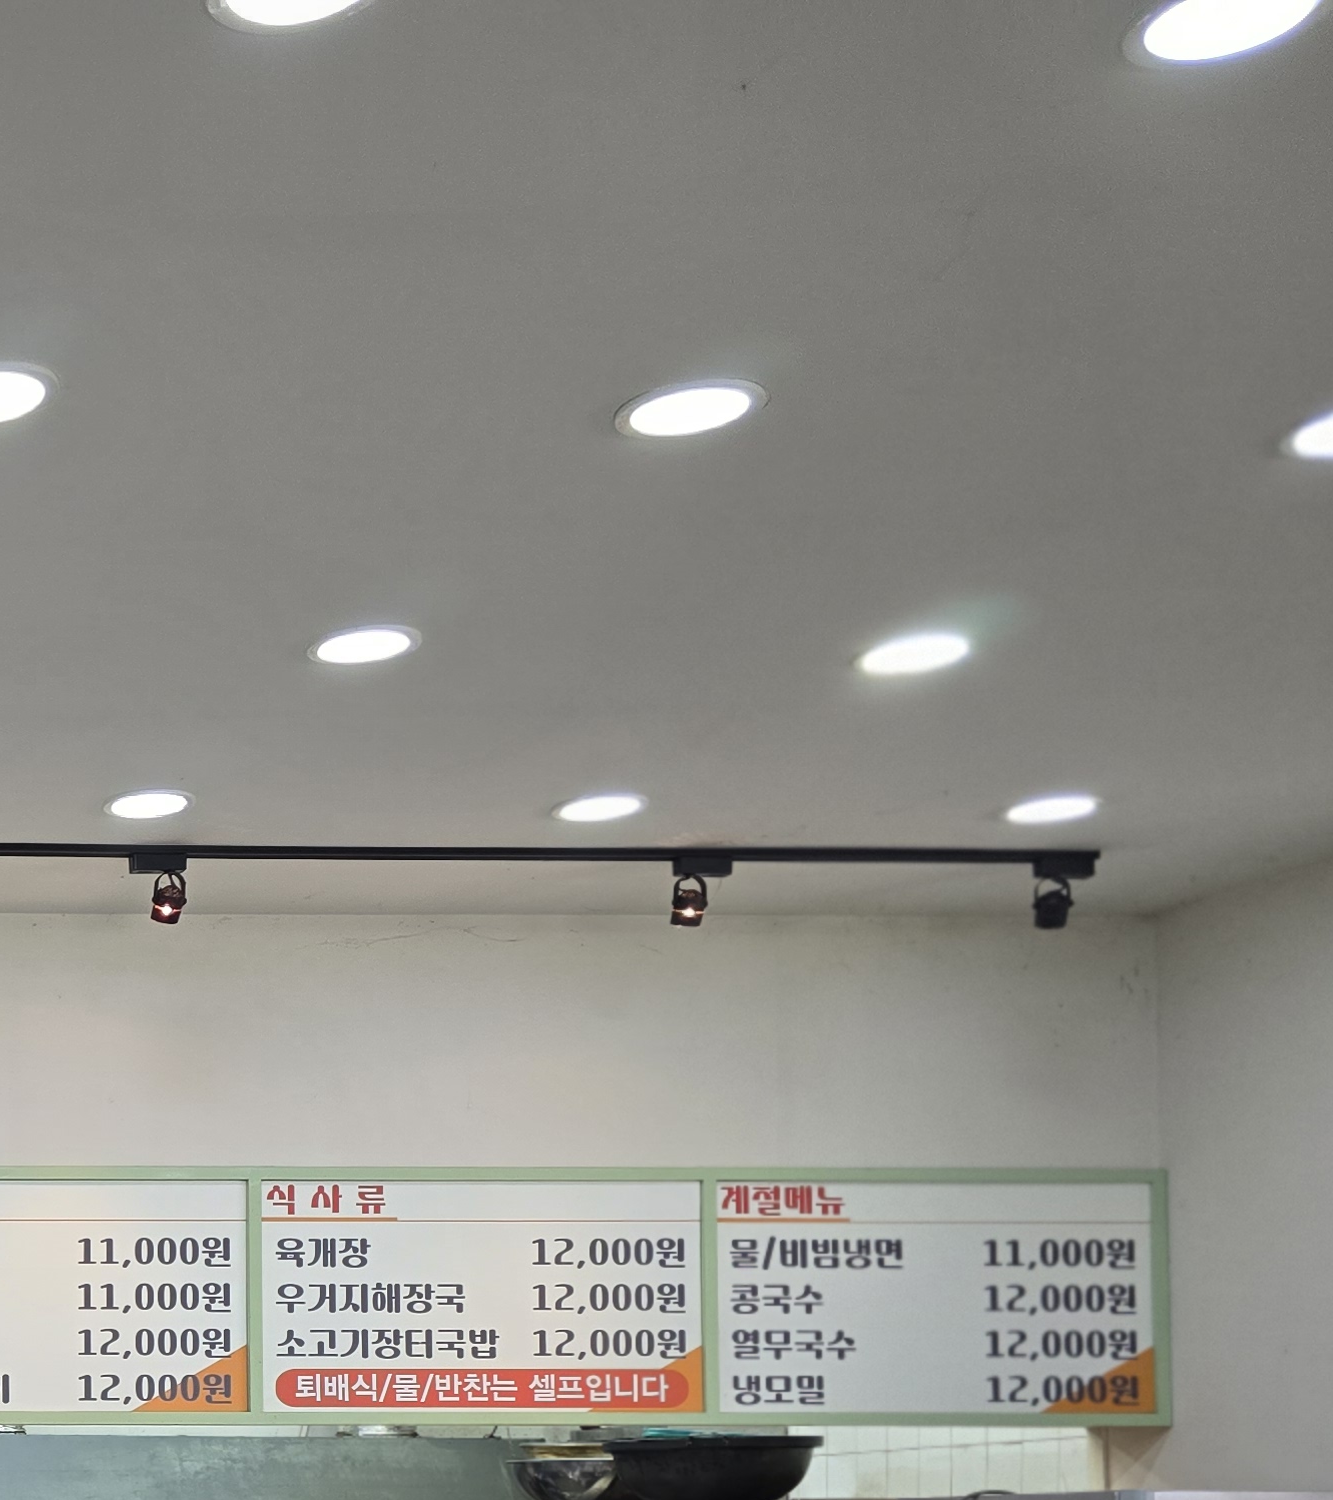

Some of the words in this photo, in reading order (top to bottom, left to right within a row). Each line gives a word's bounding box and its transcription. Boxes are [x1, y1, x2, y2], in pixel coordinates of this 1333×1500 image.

[719, 1184, 847, 1217] 계절메뉴
[77, 1237, 231, 1269] 11,000원
[275, 1237, 372, 1269] 육개장
[532, 1237, 686, 1270] 12,000원
[731, 1236, 903, 1271] 물/비빔냉면
[985, 1238, 1136, 1270] 11,000원
[77, 1282, 232, 1314] 11,000원
[275, 1282, 466, 1314] 우거지해장국
[532, 1283, 686, 1315] 12,000원
[731, 1284, 823, 1315] 콩국수
[987, 1284, 1137, 1316] 12,000원
[78, 1328, 232, 1360] 12,000원
[276, 1328, 500, 1360] 소고기장터국밥
[533, 1329, 687, 1361] 12,000원
[731, 1329, 856, 1361] 열무국수
[987, 1329, 1139, 1361] 12,000원
[78, 1373, 232, 1405] 12,000원
[295, 1373, 518, 1403] 퇴배식/물/반찬는
[528, 1373, 669, 1403] 셀프입니다
[732, 1375, 825, 1406] 냉모밀
[988, 1374, 1140, 1407] 12,000원
